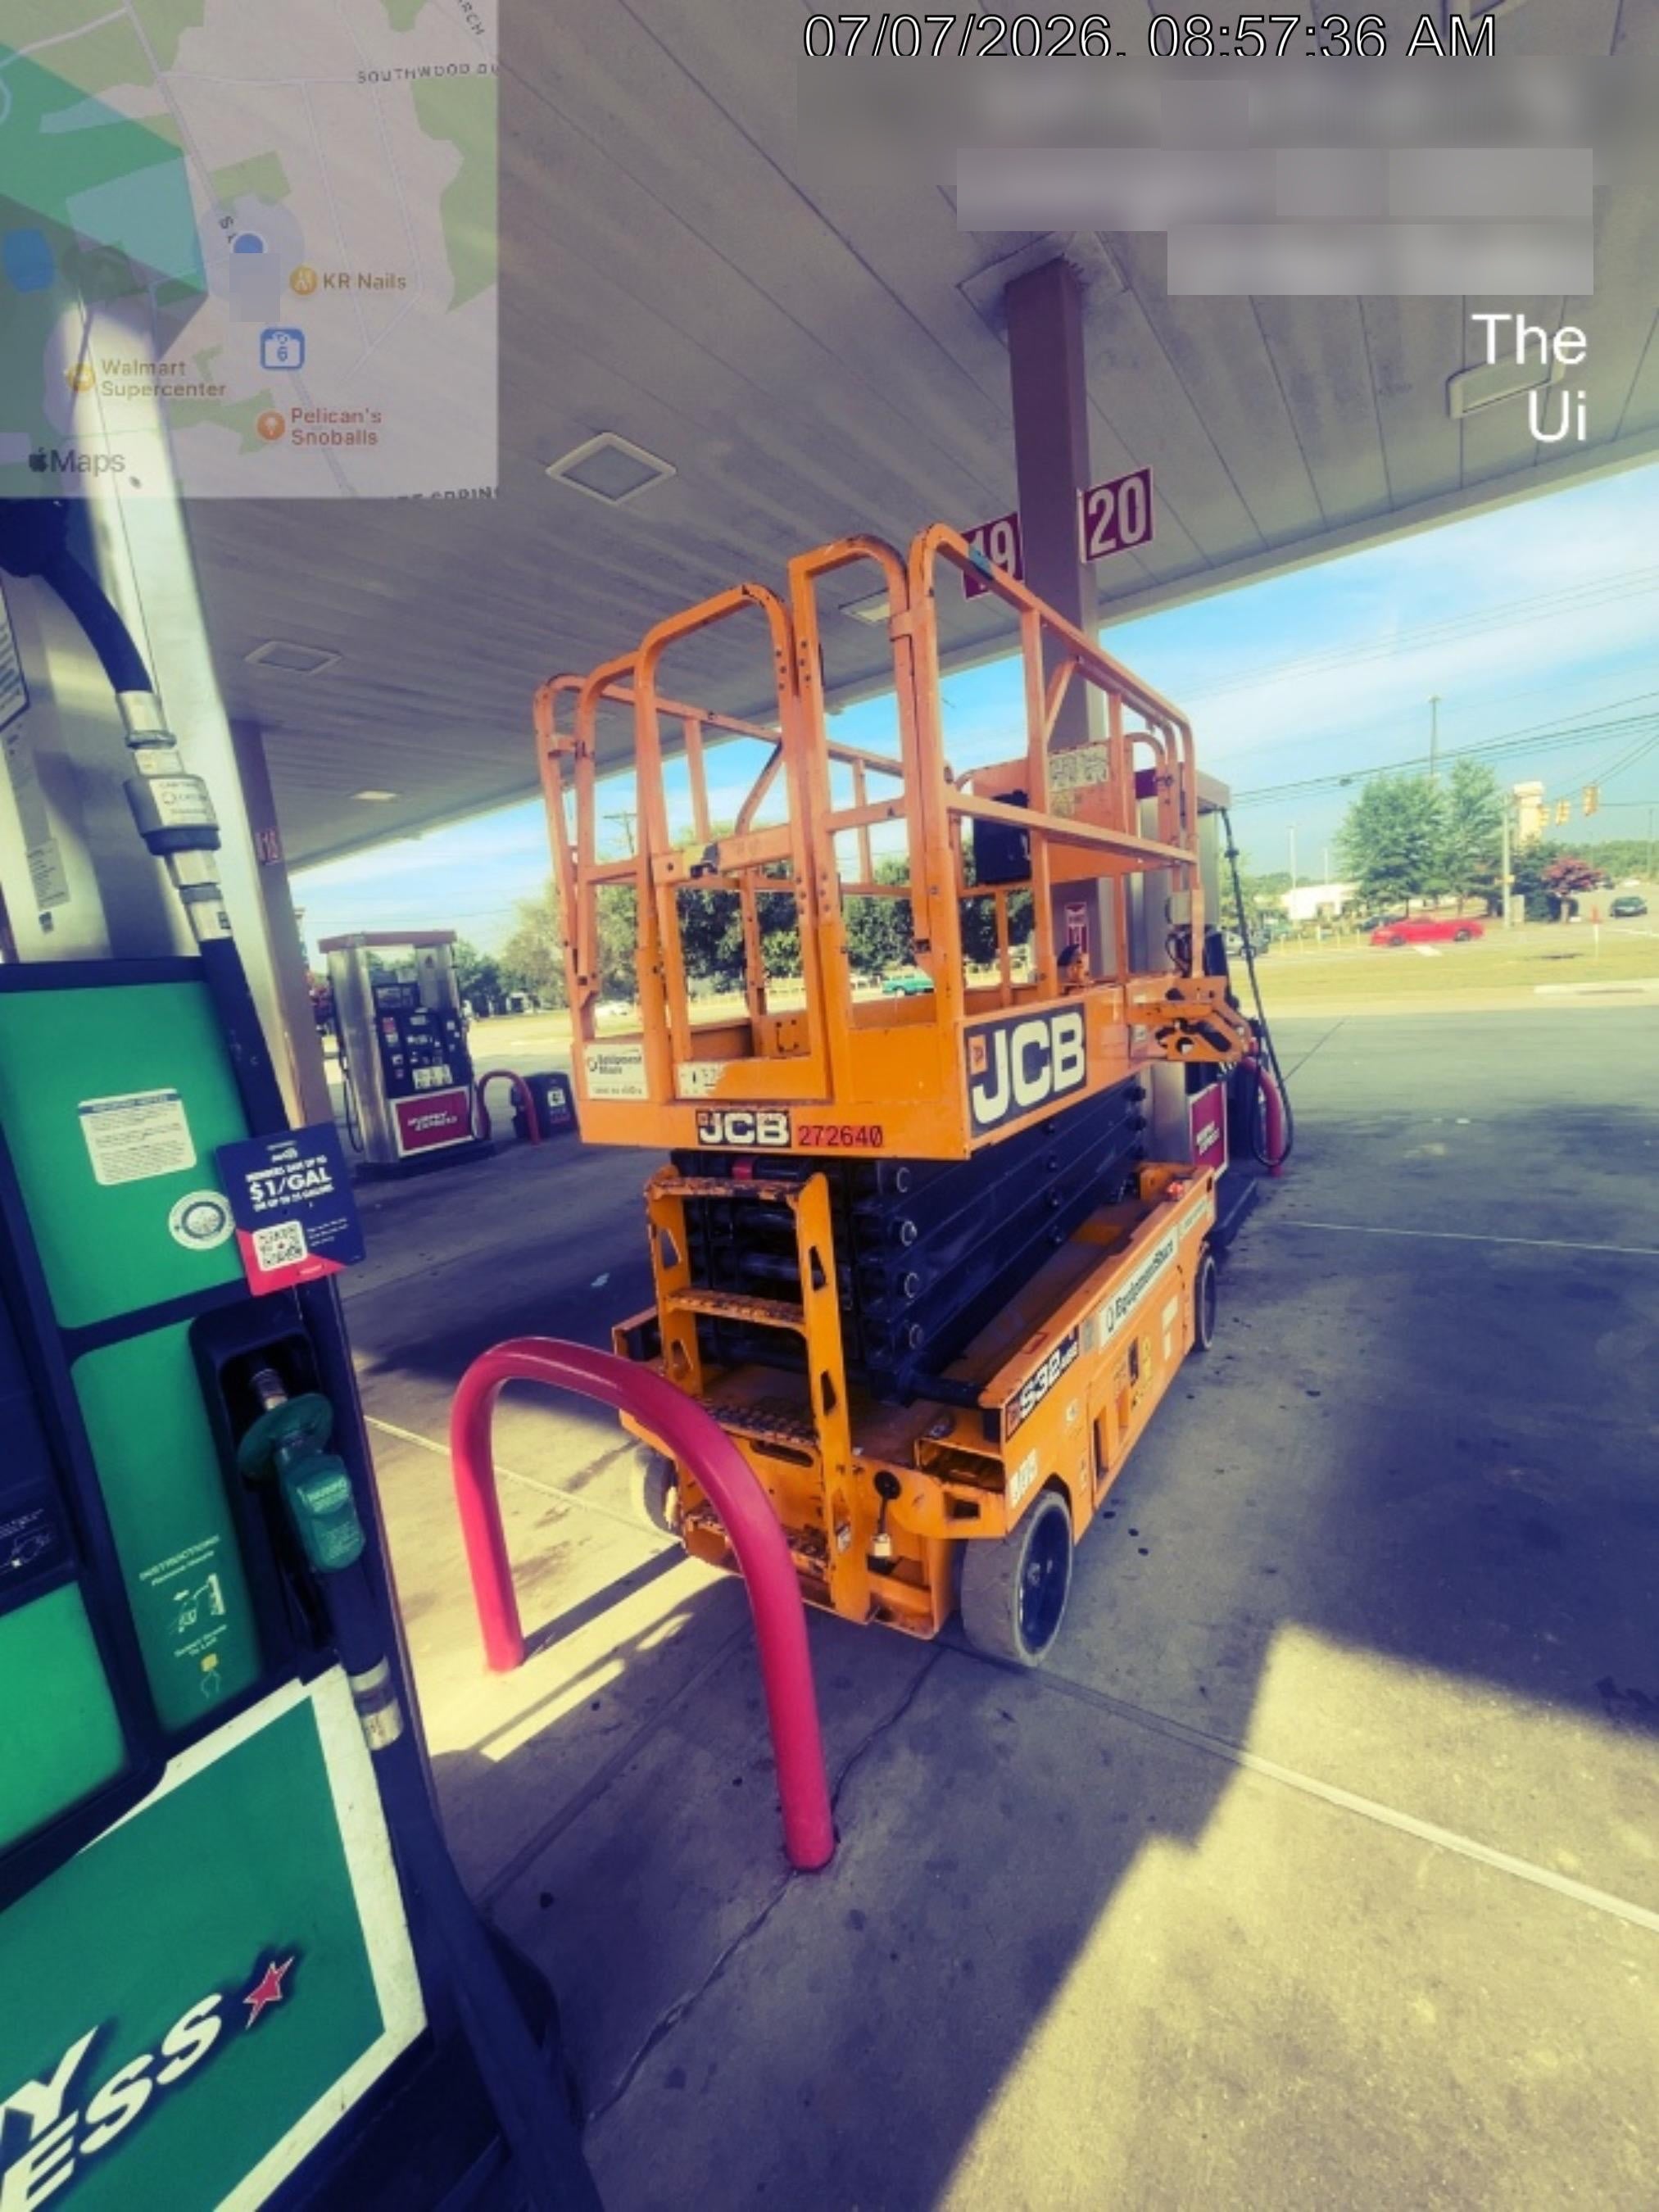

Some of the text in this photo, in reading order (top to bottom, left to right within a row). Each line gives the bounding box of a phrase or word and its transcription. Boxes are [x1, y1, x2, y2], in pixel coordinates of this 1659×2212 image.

[1088, 477, 1147, 556] 20
[972, 1012, 1086, 1124] JCB
[699, 1112, 790, 1145] JCB
[798, 1125, 884, 1147] 272640
[249, 1167, 333, 1202] $1/GAL
